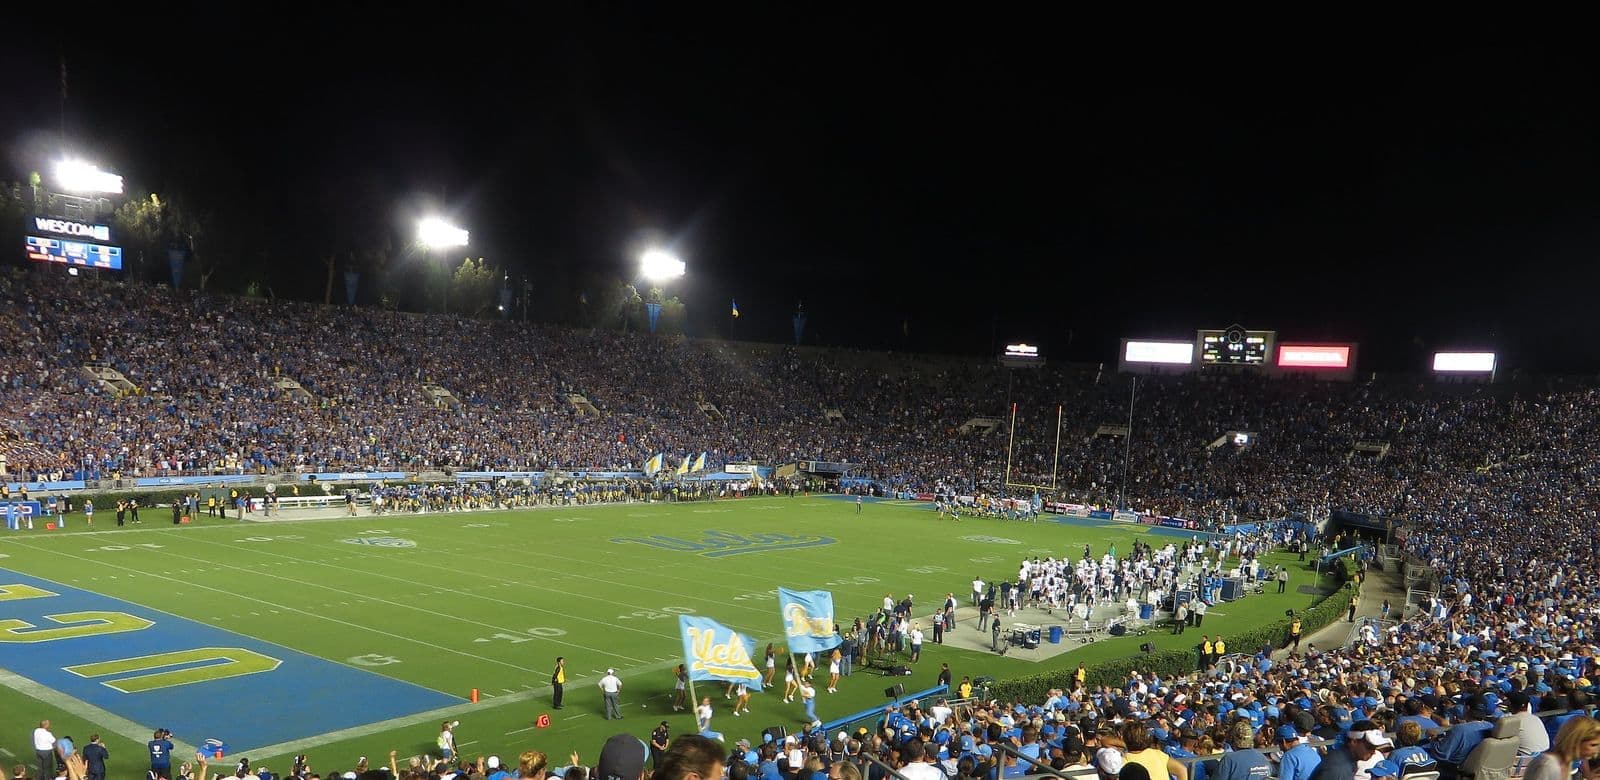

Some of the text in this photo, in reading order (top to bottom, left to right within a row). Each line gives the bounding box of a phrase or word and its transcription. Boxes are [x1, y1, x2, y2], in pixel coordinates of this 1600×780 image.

[36, 217, 95, 236] WESCOM
[491, 627, 568, 644] 10
[541, 716, 549, 726] G
